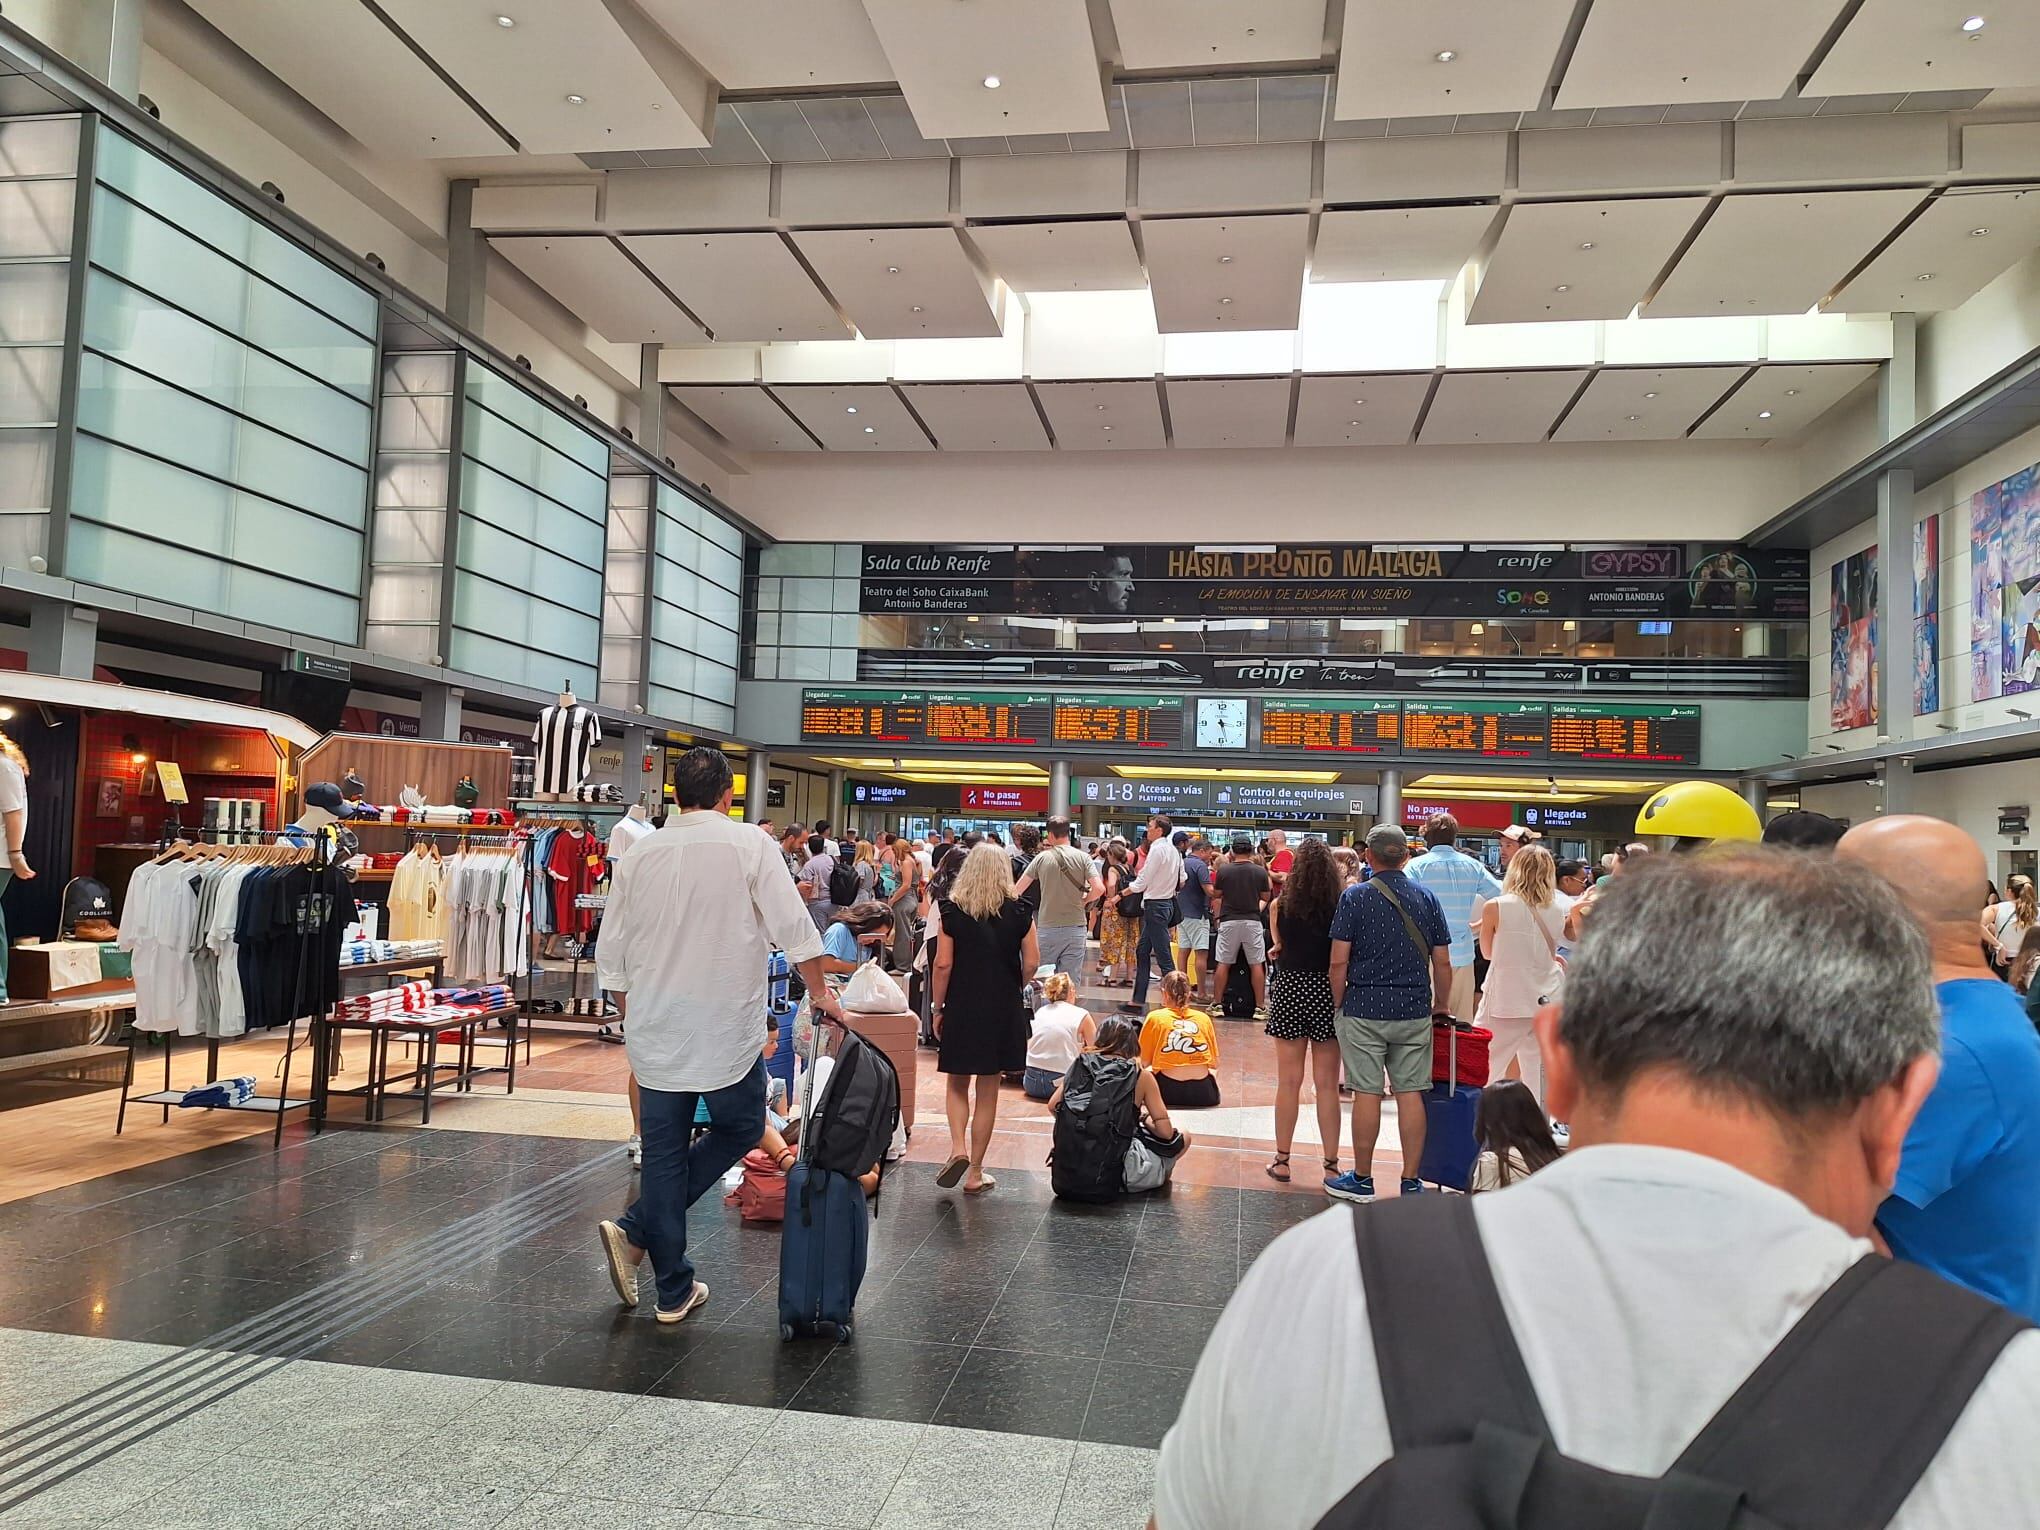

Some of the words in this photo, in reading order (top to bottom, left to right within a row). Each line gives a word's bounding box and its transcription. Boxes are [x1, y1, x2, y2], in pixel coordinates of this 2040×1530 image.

[865, 555, 901, 570] Sala
[905, 555, 941, 571] Club
[945, 555, 991, 575] Renfe
[1168, 550, 1234, 577] HASTA
[1243, 550, 1333, 577] PRONTO
[1497, 552, 1553, 572] renfe
[1591, 552, 1671, 573] GYPSY
[863, 587, 893, 597] Teatro
[896, 587, 910, 596] del
[913, 587, 937, 597] Soho
[939, 587, 989, 598] CaixaBank
[1199, 588, 1215, 599] LA
[1217, 586, 1272, 600] EMOCIÓN
[1275, 588, 1293, 599] DE
[1294, 588, 1349, 600] ENSAYAR
[1351, 588, 1368, 599] UN
[1370, 586, 1412, 600] SUEÑO
[1588, 593, 1624, 601] ANTONIO
[1625, 593, 1665, 601] BANDERAS
[884, 599, 921, 608] Antonio
[924, 600, 968, 609] Banderas
[1237, 660, 1305, 686] renfe
[1318, 667, 1336, 681] Tu
[1339, 668, 1377, 681] tren
[1217, 703, 1227, 711] 12
[399, 721, 418, 734] Venta
[600, 754, 621, 769] renfe
[871, 786, 907, 797] Llegadas
[983, 790, 995, 799] No
[997, 792, 1021, 800] pasar
[1106, 783, 1133, 801] 1-8
[1139, 783, 1171, 794] Acceso
[1174, 786, 1180, 794] a
[1183, 784, 1203, 795] vías
[1239, 787, 1275, 797] Control
[1278, 788, 1292, 798] de
[1294, 789, 1345, 800] equipajes
[1238, 798, 1270, 806] LUGGAGE
[1271, 799, 1303, 807] CONTROL
[1407, 804, 1420, 813] No
[1422, 806, 1449, 815] pasar
[1544, 808, 1587, 820] Llegadas
